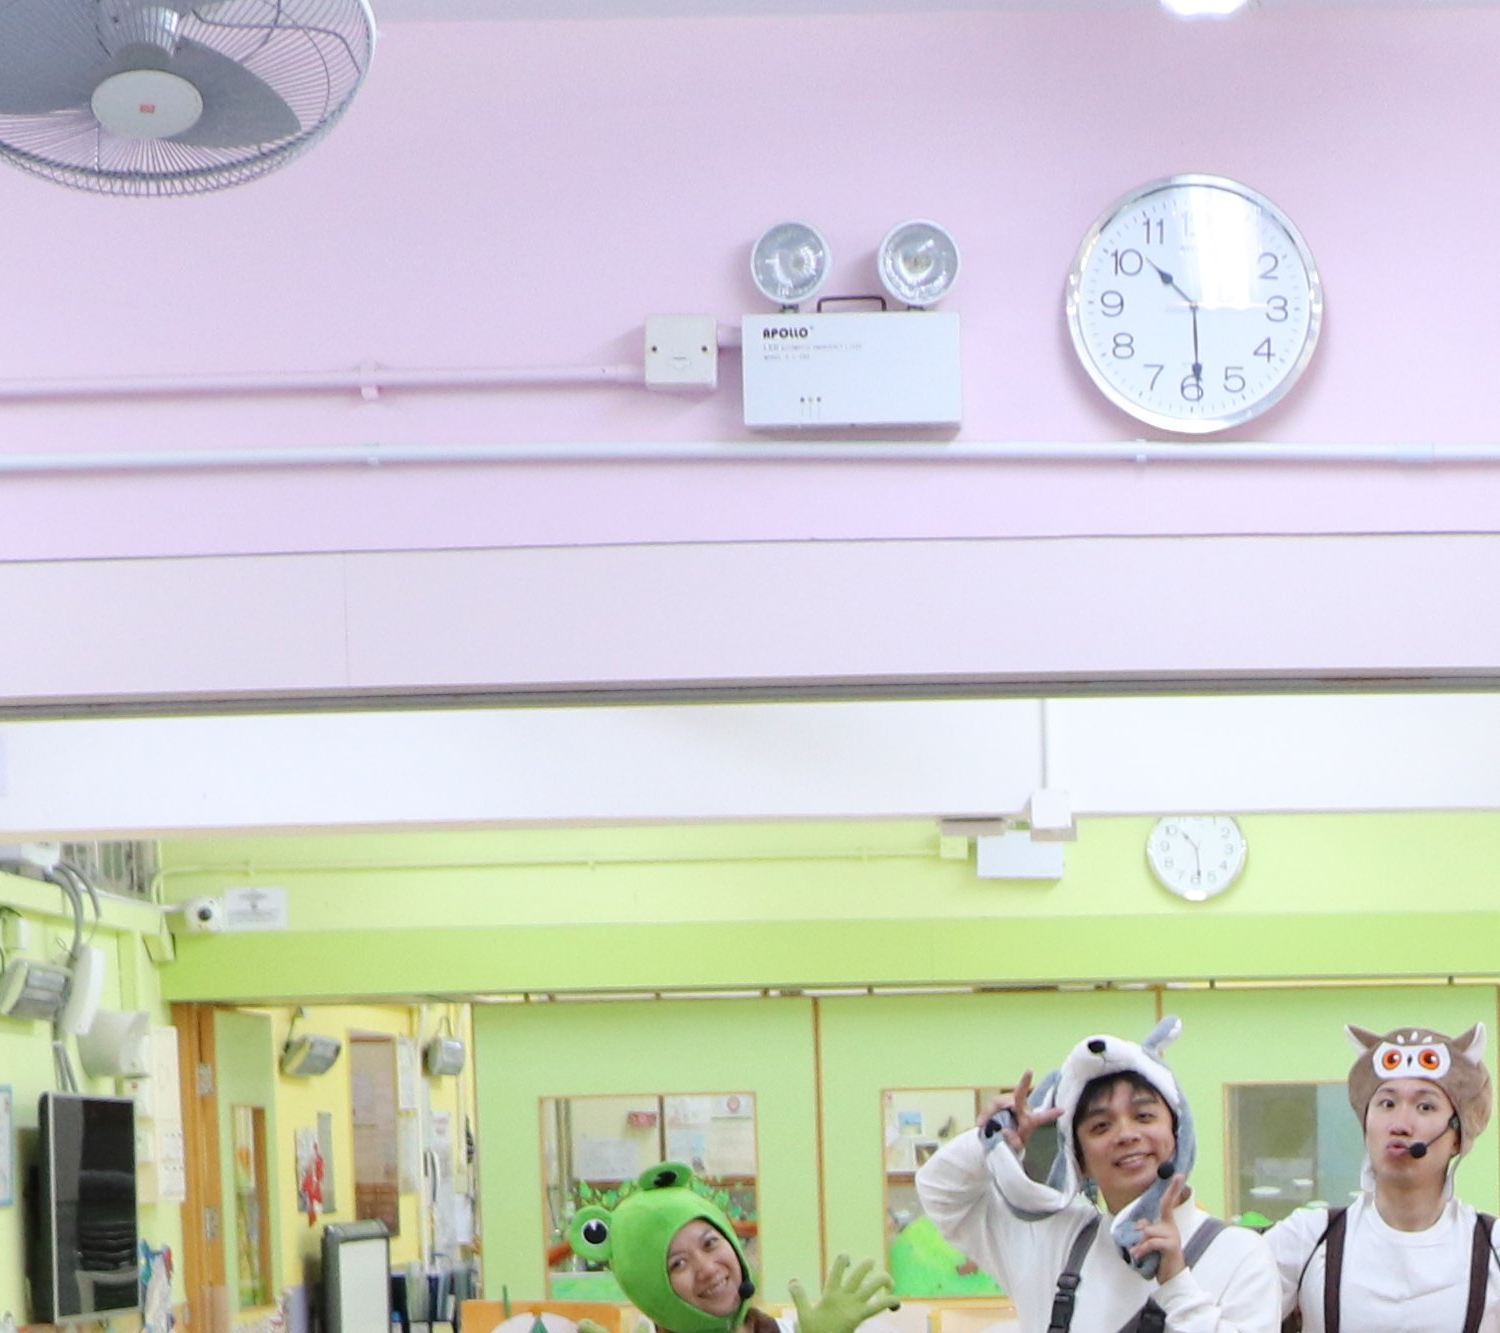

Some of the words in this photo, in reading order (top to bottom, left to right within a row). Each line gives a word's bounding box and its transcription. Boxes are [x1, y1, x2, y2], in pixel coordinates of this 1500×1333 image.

[1143, 218, 1164, 244] 11
[1111, 248, 1143, 276] 10
[1258, 252, 1279, 280] 2
[1100, 290, 1125, 317] 9
[1265, 295, 1289, 322] 3
[1112, 332, 1135, 359] 8
[1253, 336, 1276, 363] 4
[1143, 364, 1165, 391] 7
[1181, 374, 1204, 402] 6
[1223, 366, 1245, 393] 5
